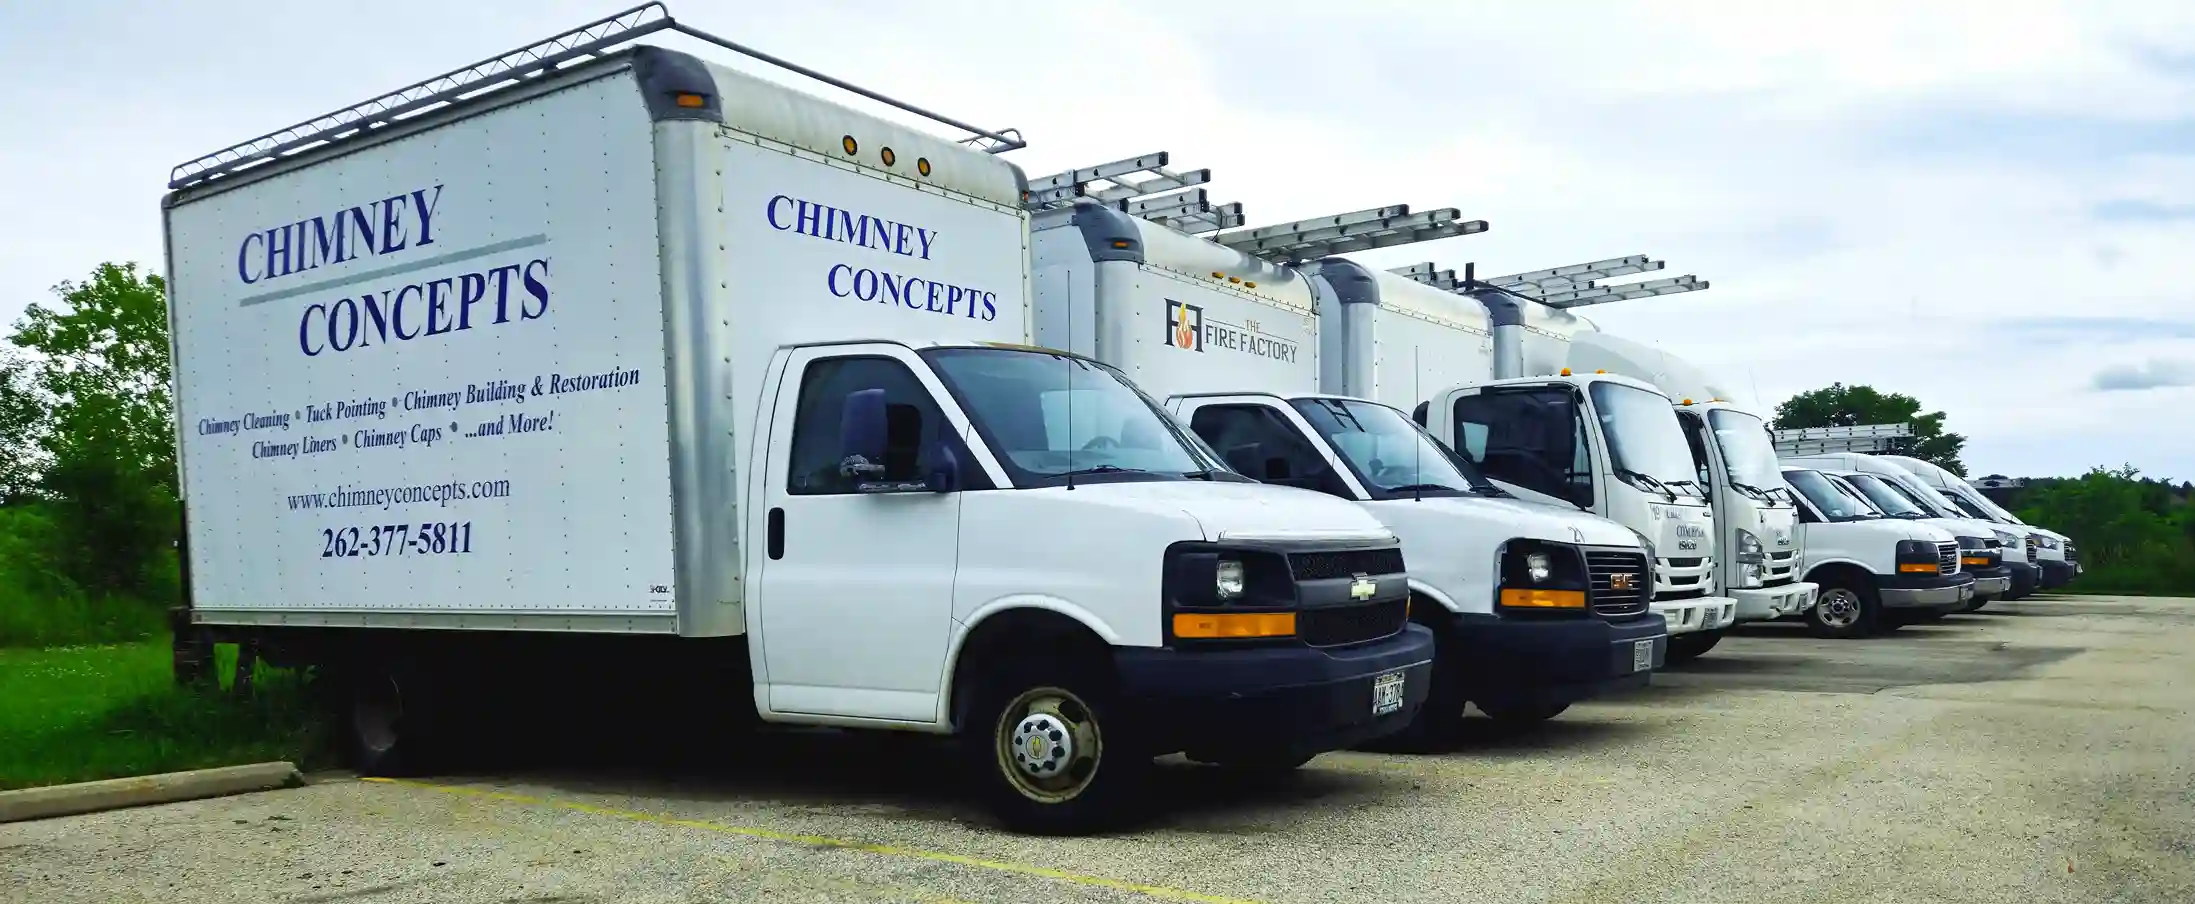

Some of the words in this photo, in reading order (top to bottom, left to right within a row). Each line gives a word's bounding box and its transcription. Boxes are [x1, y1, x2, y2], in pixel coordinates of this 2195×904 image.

[239, 184, 444, 284] CHIMNEY
[767, 194, 938, 260] CHIMNEY
[300, 259, 549, 356] CONCEPTS
[828, 263, 996, 321] CONCEPTS
[1205, 325, 1237, 350] FIRE
[1240, 332, 1298, 364] FACTORY
[1245, 320, 1261, 333] THE
[198, 417, 241, 436] Chimney
[243, 411, 290, 431] Cleaning
[306, 402, 333, 423] Tuck
[336, 398, 387, 420] Pointing
[404, 389, 461, 411] Chimney
[466, 380, 527, 404] Building
[531, 375, 544, 397] &
[549, 366, 640, 395] Restoration
[252, 440, 299, 460] Chimney
[302, 435, 337, 454] Liners
[354, 429, 407, 449] Chimney
[411, 423, 442, 447] Caps
[508, 410, 554, 435] More!
[288, 479, 511, 511] www.chimneyconcepts.com
[322, 520, 473, 557] 262-377-5811
